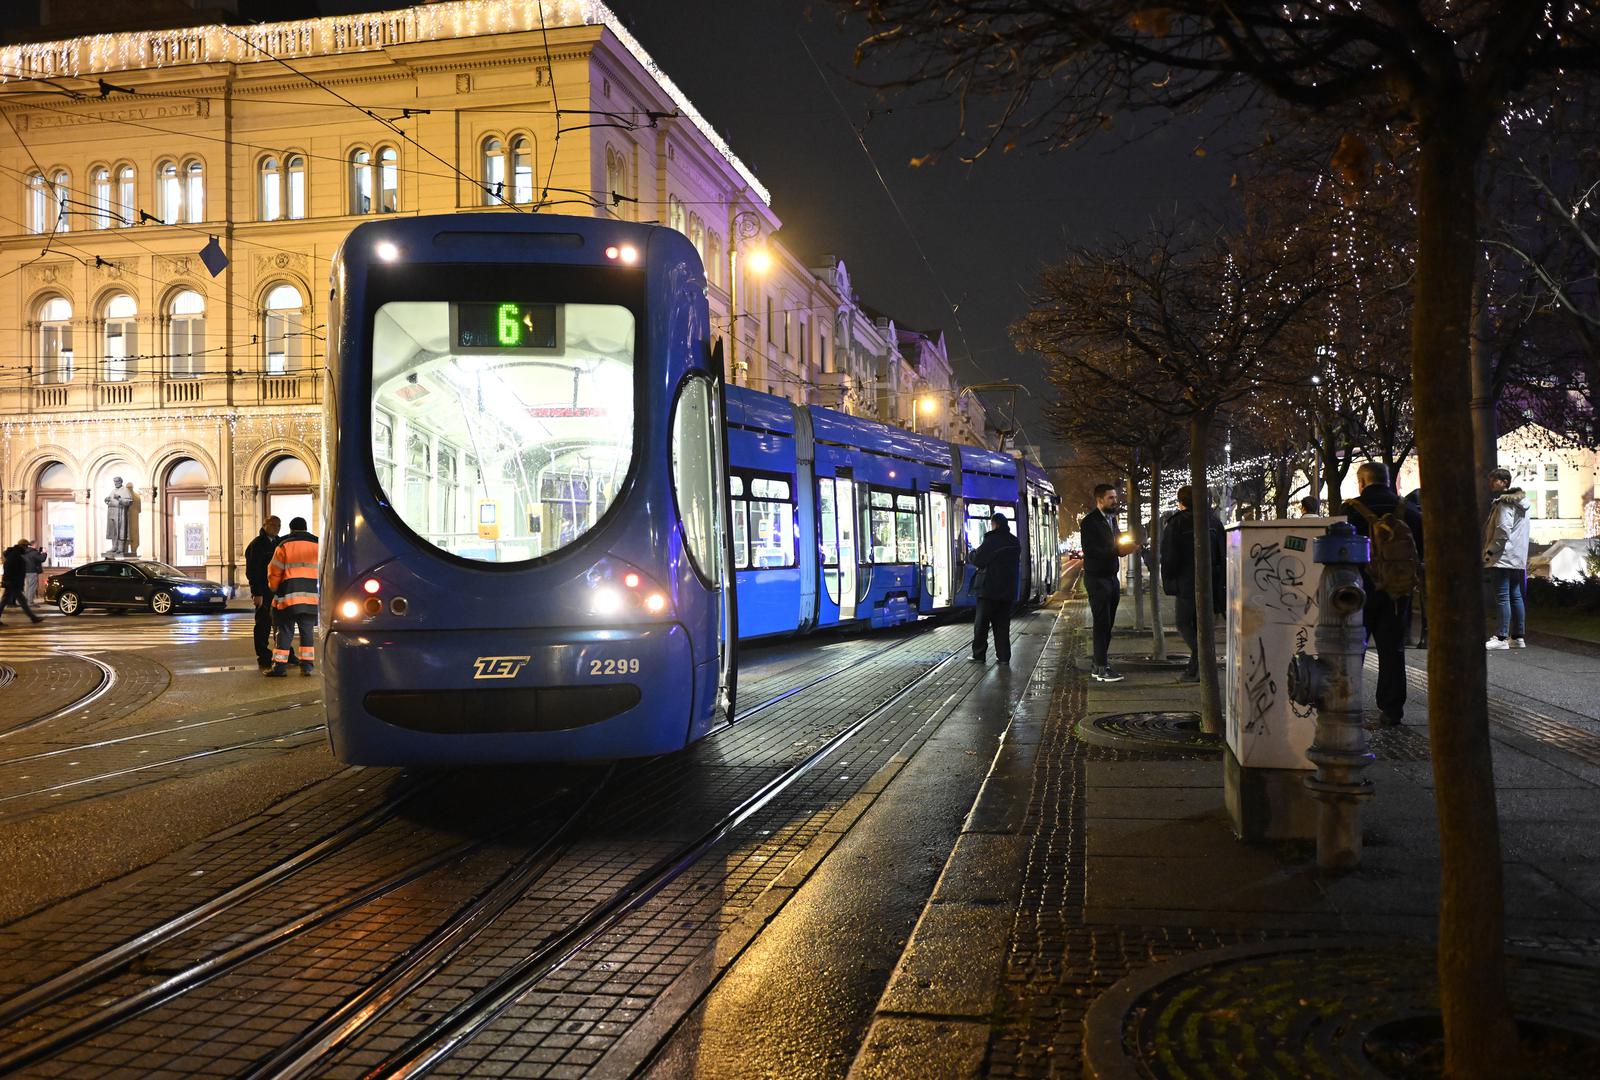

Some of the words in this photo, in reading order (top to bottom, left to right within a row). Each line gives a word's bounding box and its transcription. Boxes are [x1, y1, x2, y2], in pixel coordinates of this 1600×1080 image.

[157, 104, 193, 117] DOM
[499, 304, 519, 344] 6
[473, 655, 531, 680] ZET
[590, 658, 640, 675] 2299
